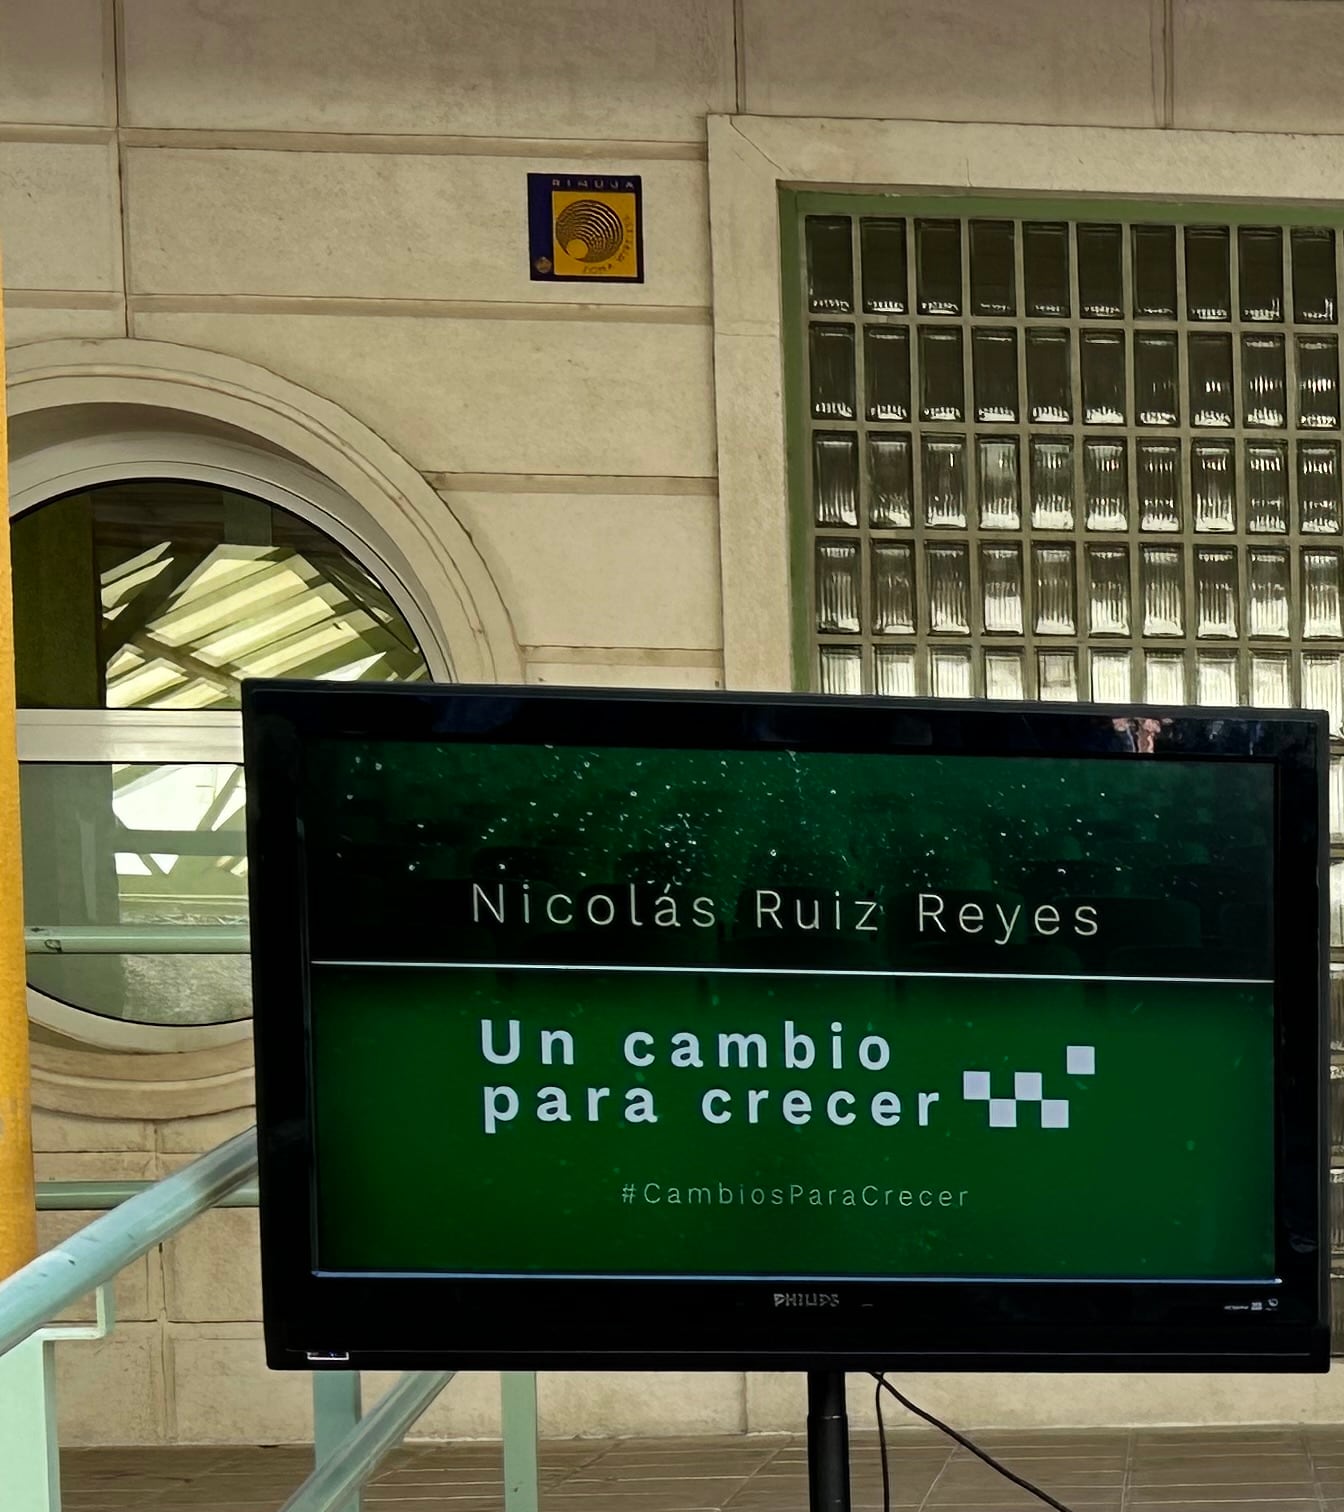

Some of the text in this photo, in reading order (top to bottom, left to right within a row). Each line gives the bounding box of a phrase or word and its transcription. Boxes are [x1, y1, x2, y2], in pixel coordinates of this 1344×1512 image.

[472, 880, 1099, 945] Nicolás Ruiz Reyes
[481, 1018, 891, 1072] Un cambio
[483, 1086, 941, 1134] para crecer
[620, 1182, 970, 1208] #CambiosParaCrecer
